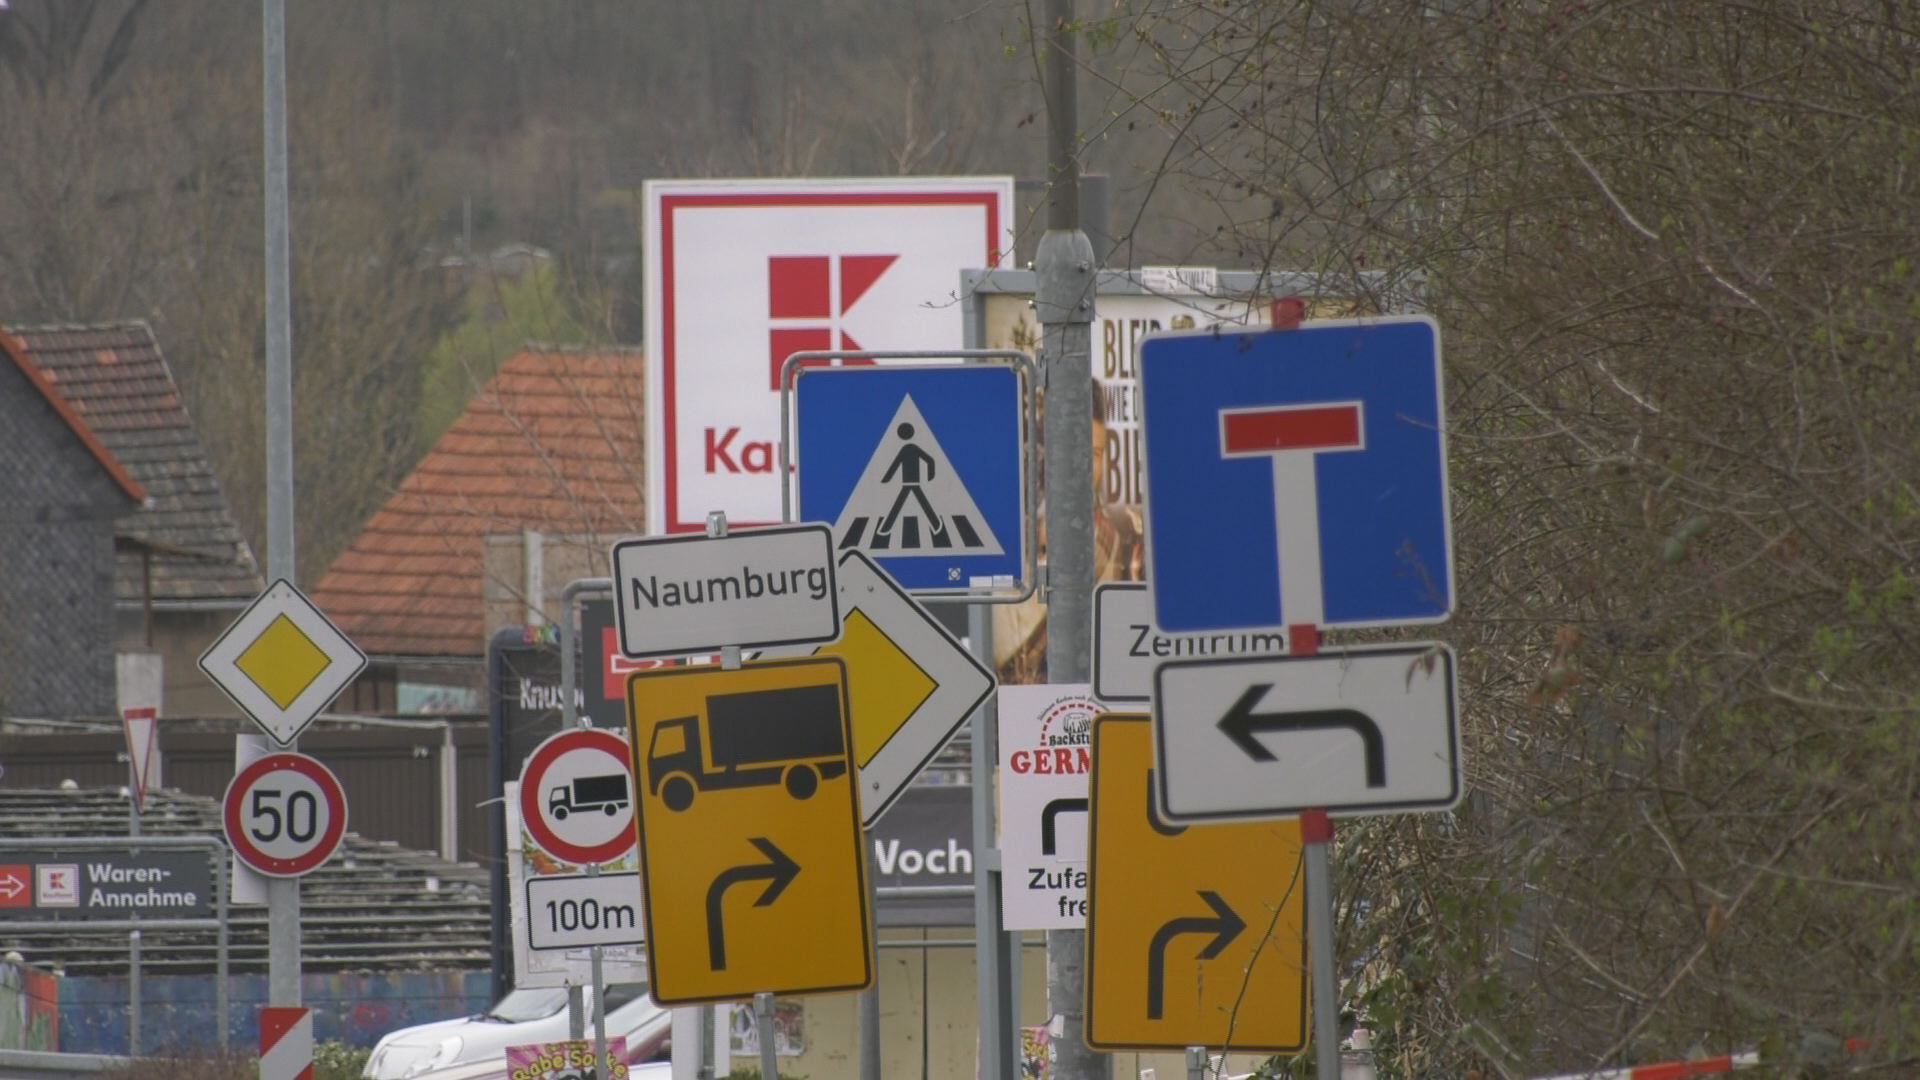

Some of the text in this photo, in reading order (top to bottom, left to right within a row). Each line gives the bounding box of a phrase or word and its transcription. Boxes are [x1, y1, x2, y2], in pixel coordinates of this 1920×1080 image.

[1103, 319, 1162, 379] BLE
[705, 427, 796, 473] Ka
[631, 566, 828, 611] Naumburg
[1129, 624, 1285, 657] Zentrum
[251, 790, 317, 843] 50
[88, 864, 171, 883] Waren-
[88, 887, 197, 908] Annahme
[546, 898, 635, 933] 100m
[570, 1050, 627, 1079] Soke
